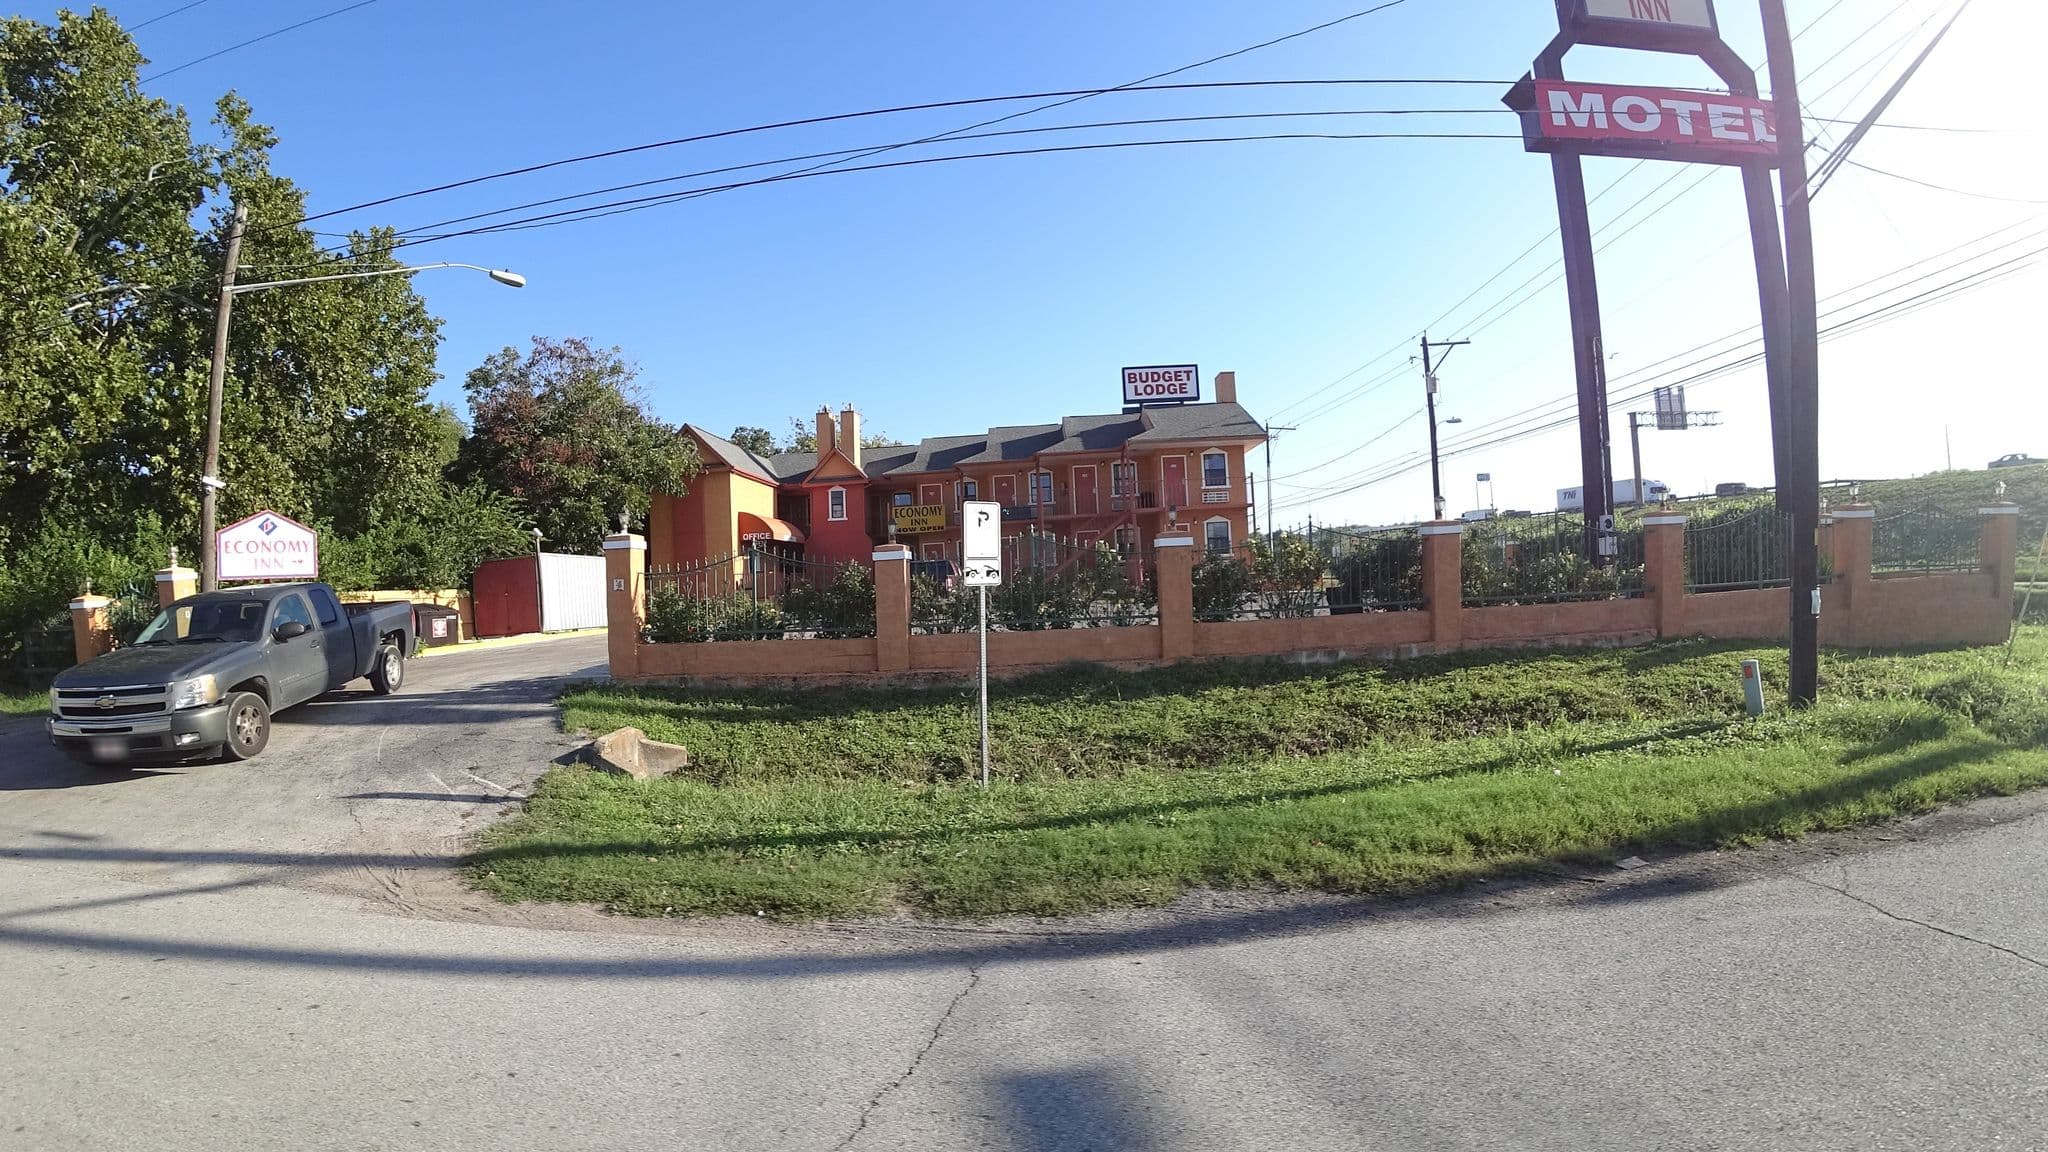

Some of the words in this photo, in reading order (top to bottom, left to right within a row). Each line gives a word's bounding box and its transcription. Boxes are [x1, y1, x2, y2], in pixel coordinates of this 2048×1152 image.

[1628, 0, 1672, 22] INN
[1548, 90, 1776, 143] MOTEL
[1127, 370, 1192, 383] BUDGET
[1134, 383, 1188, 396] LODGE
[894, 506, 943, 518] ECONOMY
[910, 518, 928, 526] INN
[743, 532, 772, 540] OFFICE
[224, 540, 310, 554] ECONOMY
[253, 558, 284, 570] INN
